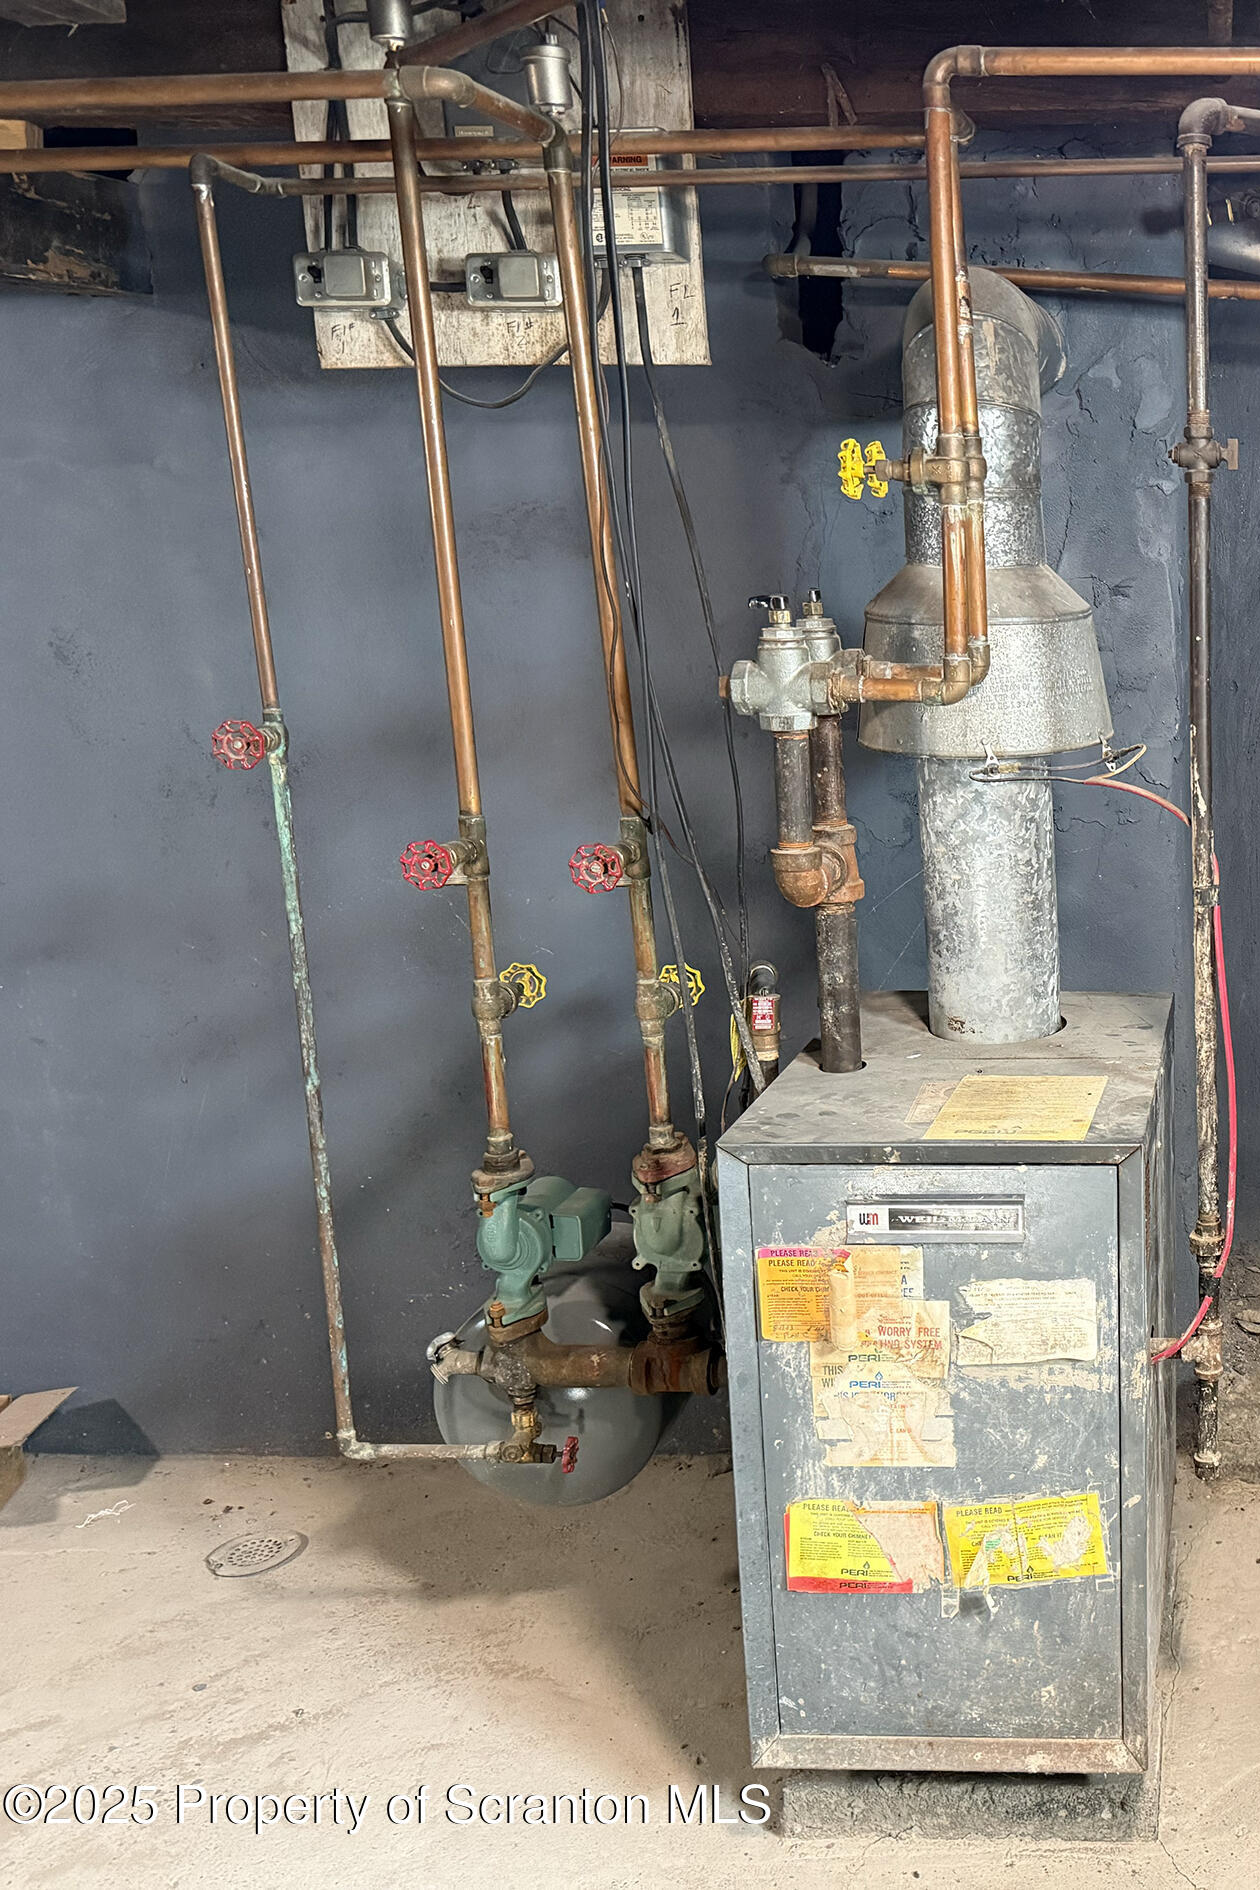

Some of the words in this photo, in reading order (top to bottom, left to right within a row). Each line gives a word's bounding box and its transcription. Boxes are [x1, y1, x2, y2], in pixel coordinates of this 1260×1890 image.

[611, 156, 643, 164] ARNING
[770, 1249, 797, 1257] PLEASE
[768, 1259, 795, 1267] PLEASE
[877, 1327, 912, 1337] WORRY
[918, 1327, 941, 1338] FREE
[823, 1365, 844, 1375] THIS
[849, 1380, 881, 1388] PERI
[803, 1503, 830, 1511] PLEASE
[956, 1508, 983, 1517] PLEASE
[984, 1506, 1003, 1515] READ
[841, 1568, 869, 1577] PERI
